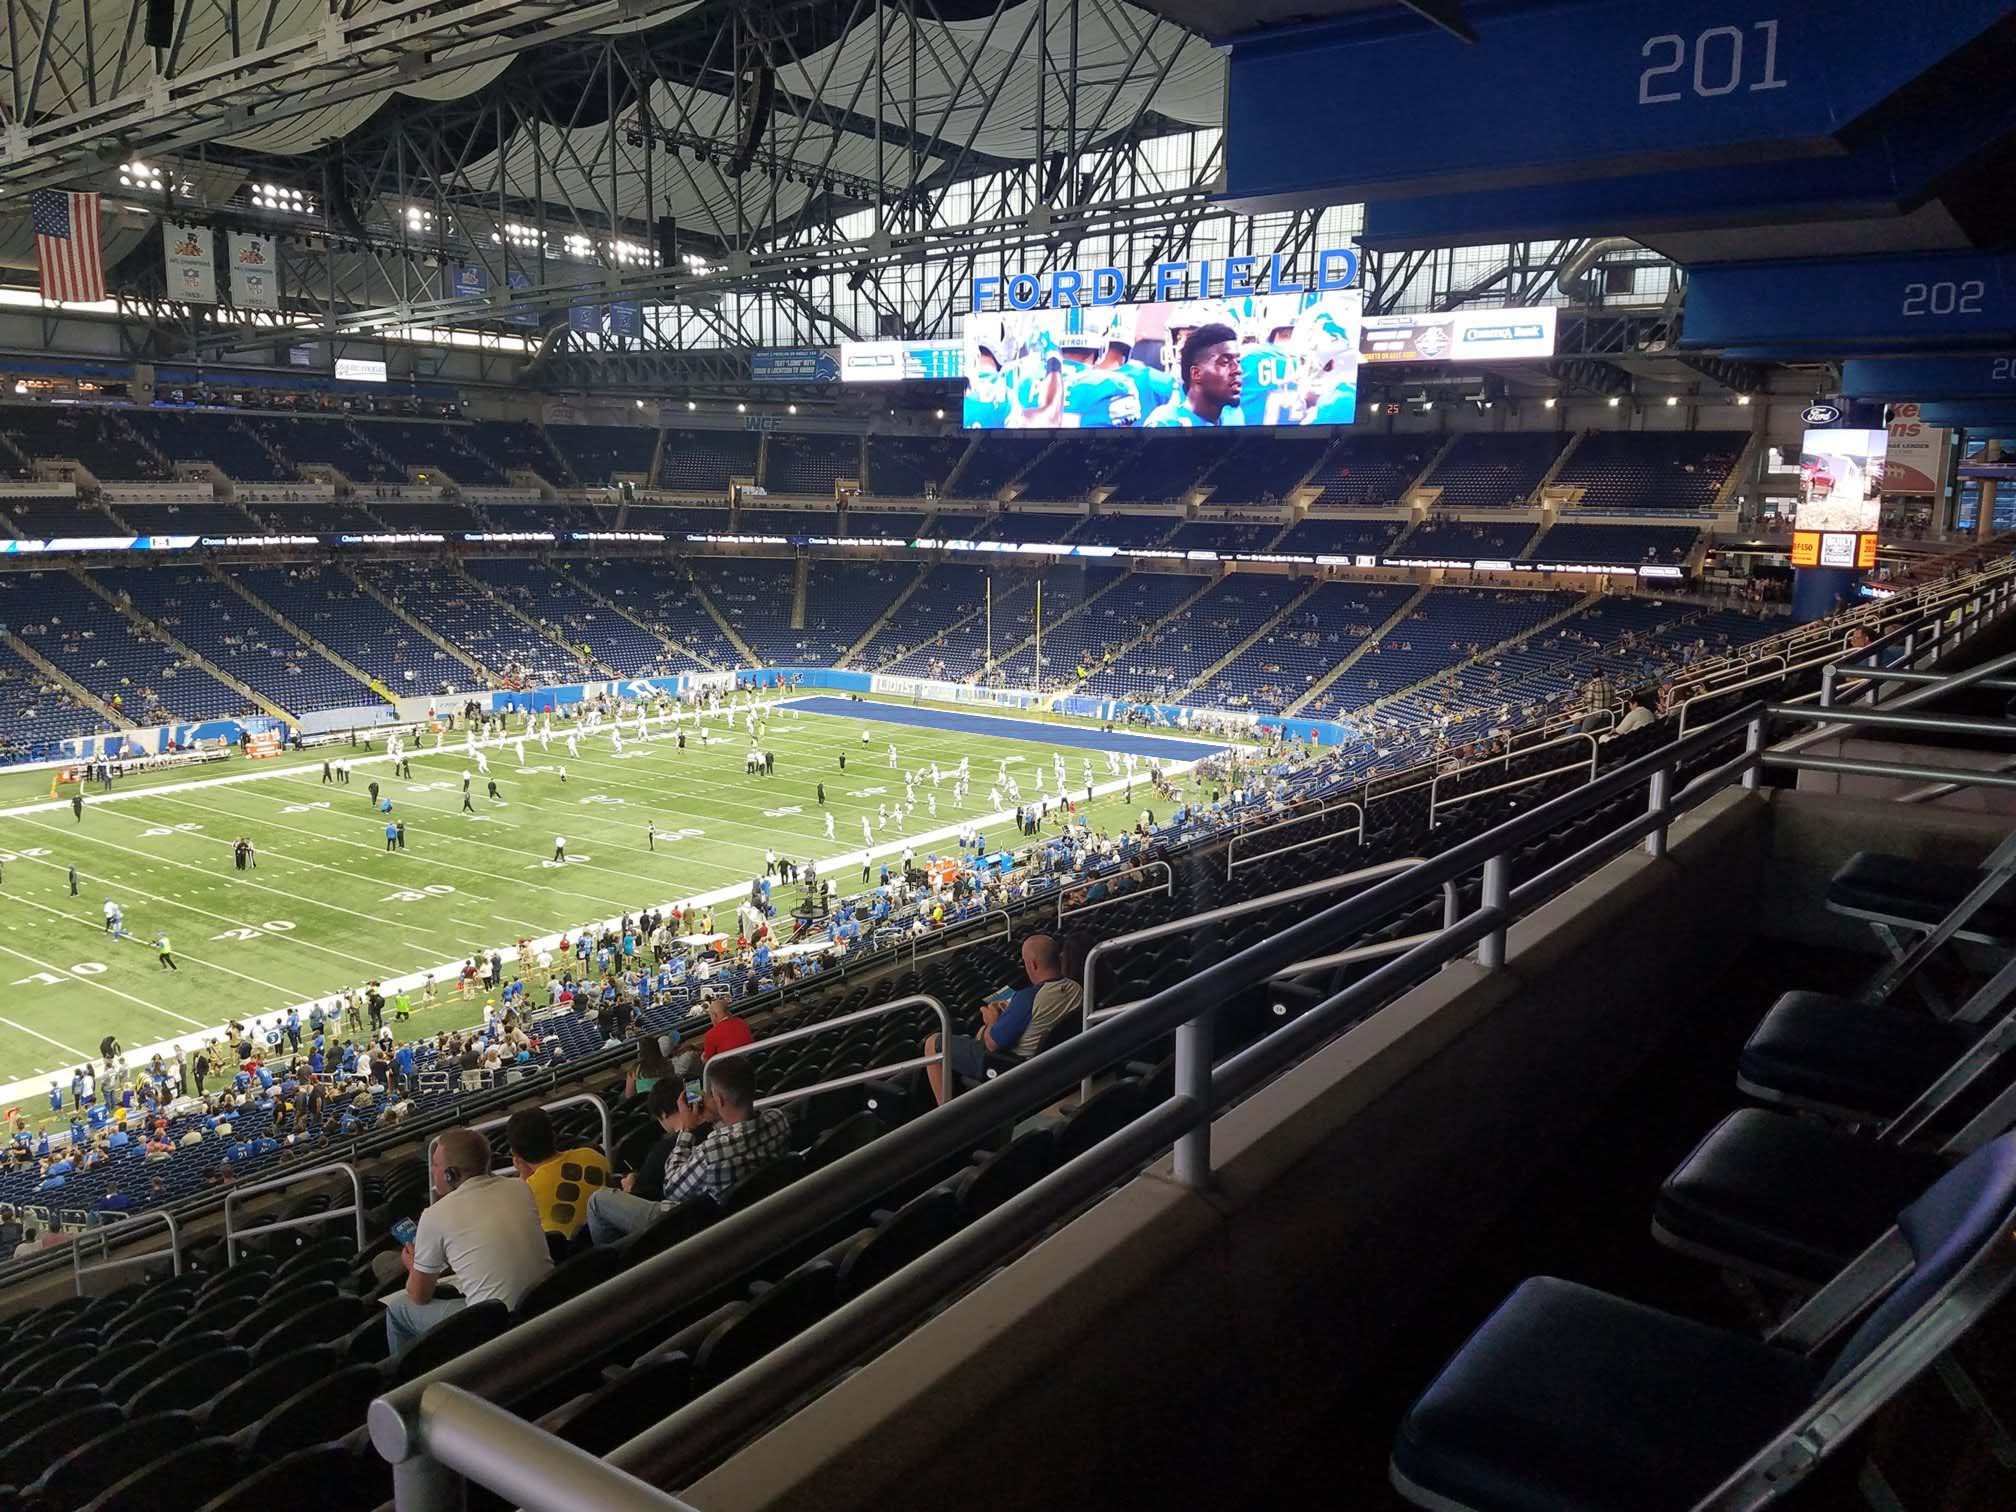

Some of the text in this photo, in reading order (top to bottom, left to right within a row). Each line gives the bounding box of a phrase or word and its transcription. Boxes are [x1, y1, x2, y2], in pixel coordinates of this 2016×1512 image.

[1639, 19, 1788, 104] 201
[971, 247, 1360, 313] FORD FIELD
[1902, 280, 1985, 316] 202
[1387, 404, 1399, 413] 25
[1807, 408, 1832, 421] Ford
[391, 884, 456, 901] 30
[223, 920, 297, 941] 20
[27, 962, 108, 985] 10
